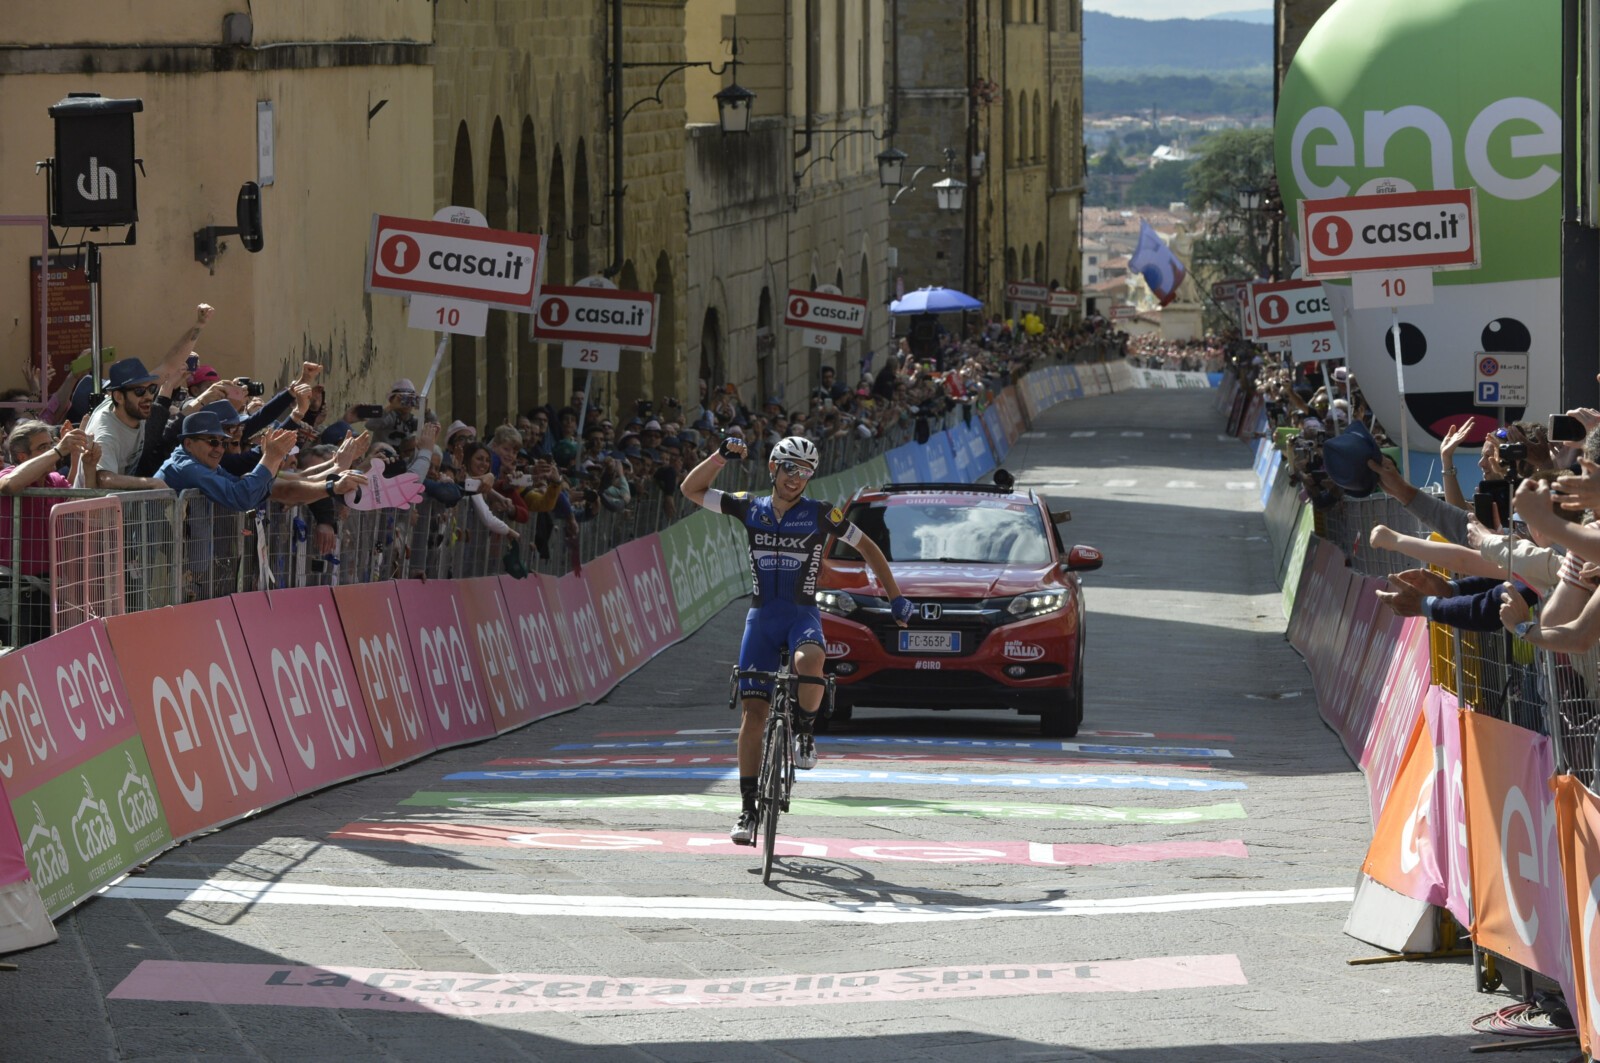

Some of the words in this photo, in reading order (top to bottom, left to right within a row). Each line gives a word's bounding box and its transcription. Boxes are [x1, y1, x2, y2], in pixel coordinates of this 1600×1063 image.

[1361, 210, 1459, 245] casa.it
[428, 249, 523, 280] casa.it
[1381, 278, 1406, 298] 10
[436, 307, 460, 326] 10
[575, 305, 645, 326] casa.it
[812, 304, 860, 323] casa.it
[579, 349, 599, 363] 25
[814, 335, 827, 346] 50
[1311, 339, 1331, 353] 25
[784, 520, 813, 528] latexco
[634, 544, 676, 643] enel
[602, 562, 644, 667] enel
[477, 590, 529, 718] enel
[519, 586, 570, 702] enel
[359, 597, 425, 749] enel
[420, 594, 485, 731] enel
[915, 660, 941, 670] #GIRO
[57, 626, 124, 742] enel
[271, 603, 367, 770] enel
[152, 619, 274, 812] enel
[264, 969, 351, 989] La
[361, 971, 685, 998] Gazzetta
[703, 974, 881, 995] dello
[891, 964, 1102, 986] Sport
